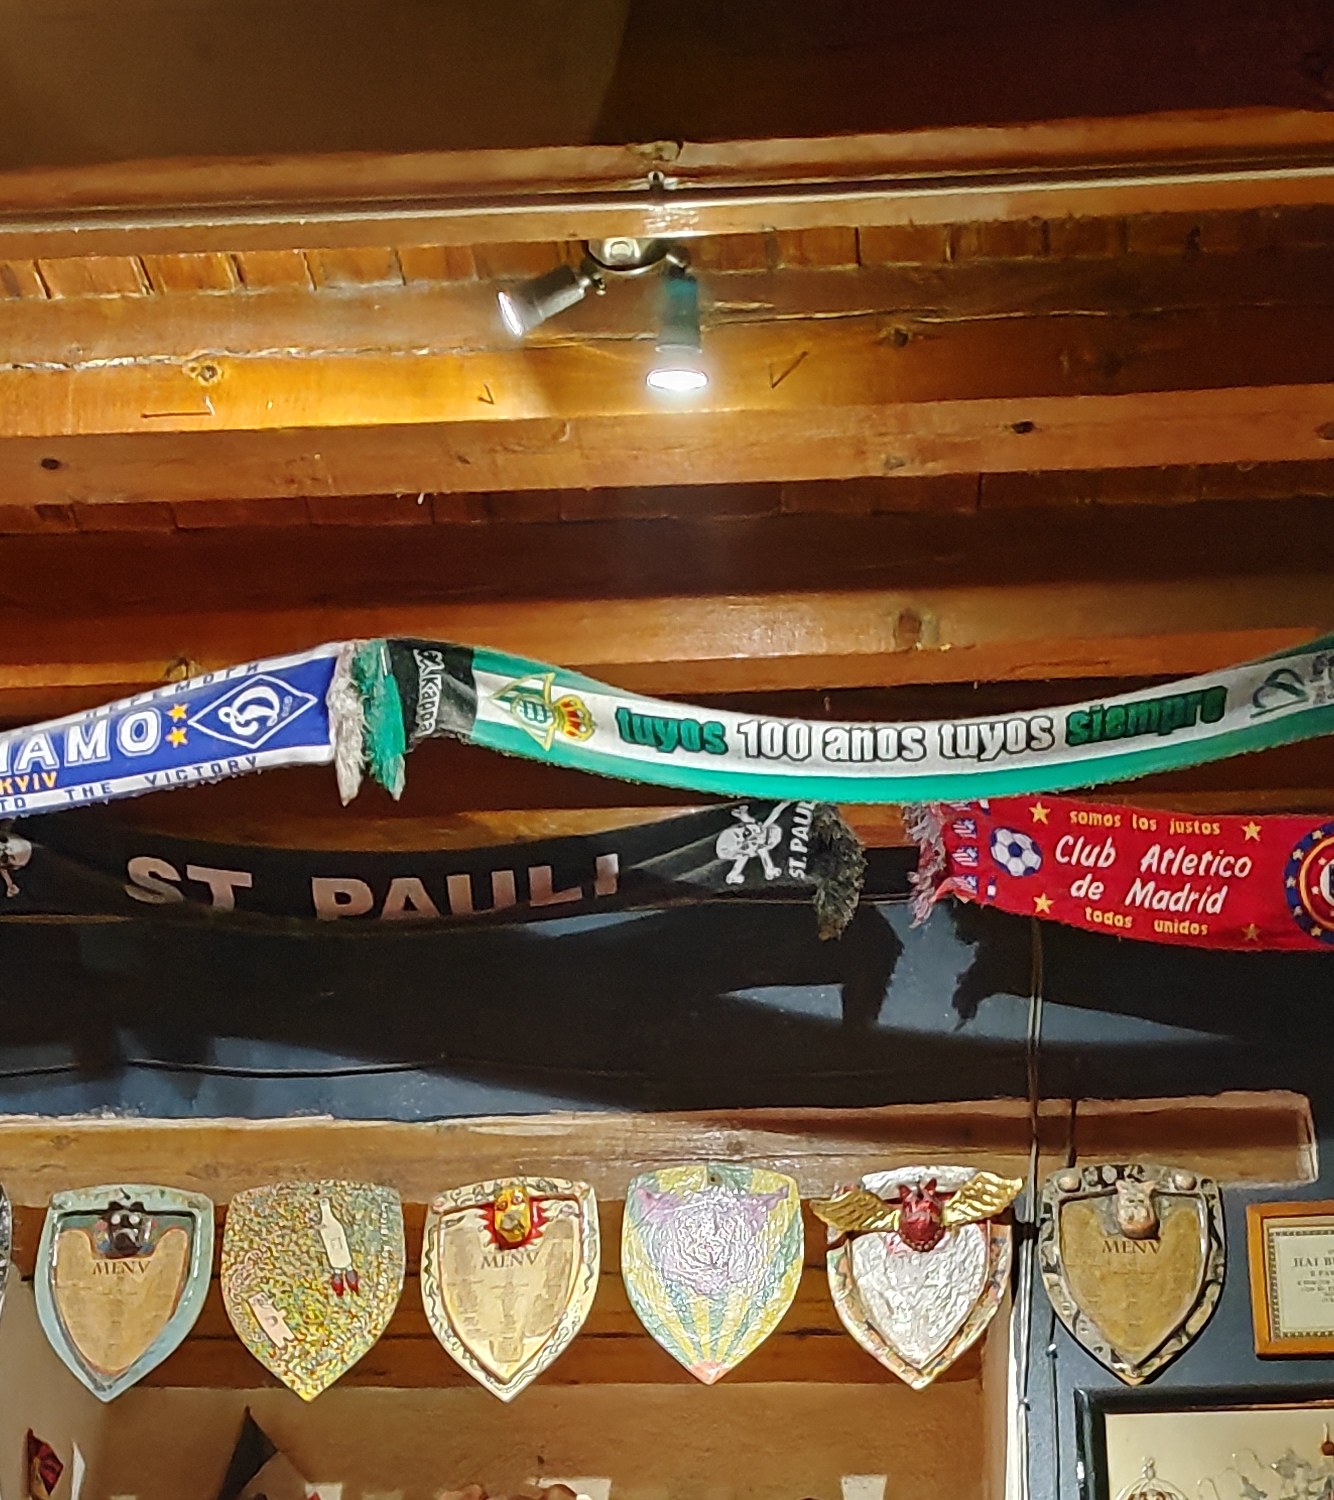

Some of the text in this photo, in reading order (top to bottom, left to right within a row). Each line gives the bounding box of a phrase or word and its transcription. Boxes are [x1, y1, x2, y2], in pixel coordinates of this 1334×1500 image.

[417, 674, 439, 736] Kappa
[614, 686, 1229, 763] tuyos 100 tuyos siempre
[64, 781, 113, 801] THE
[145, 754, 260, 789] VICTORY
[1070, 811, 1221, 836] somos los justos
[1055, 834, 1253, 879] Club Atletico
[123, 852, 619, 922] ST PAULI
[1070, 873, 1229, 915] de Madrid
[1084, 908, 1209, 936] todos unidos
